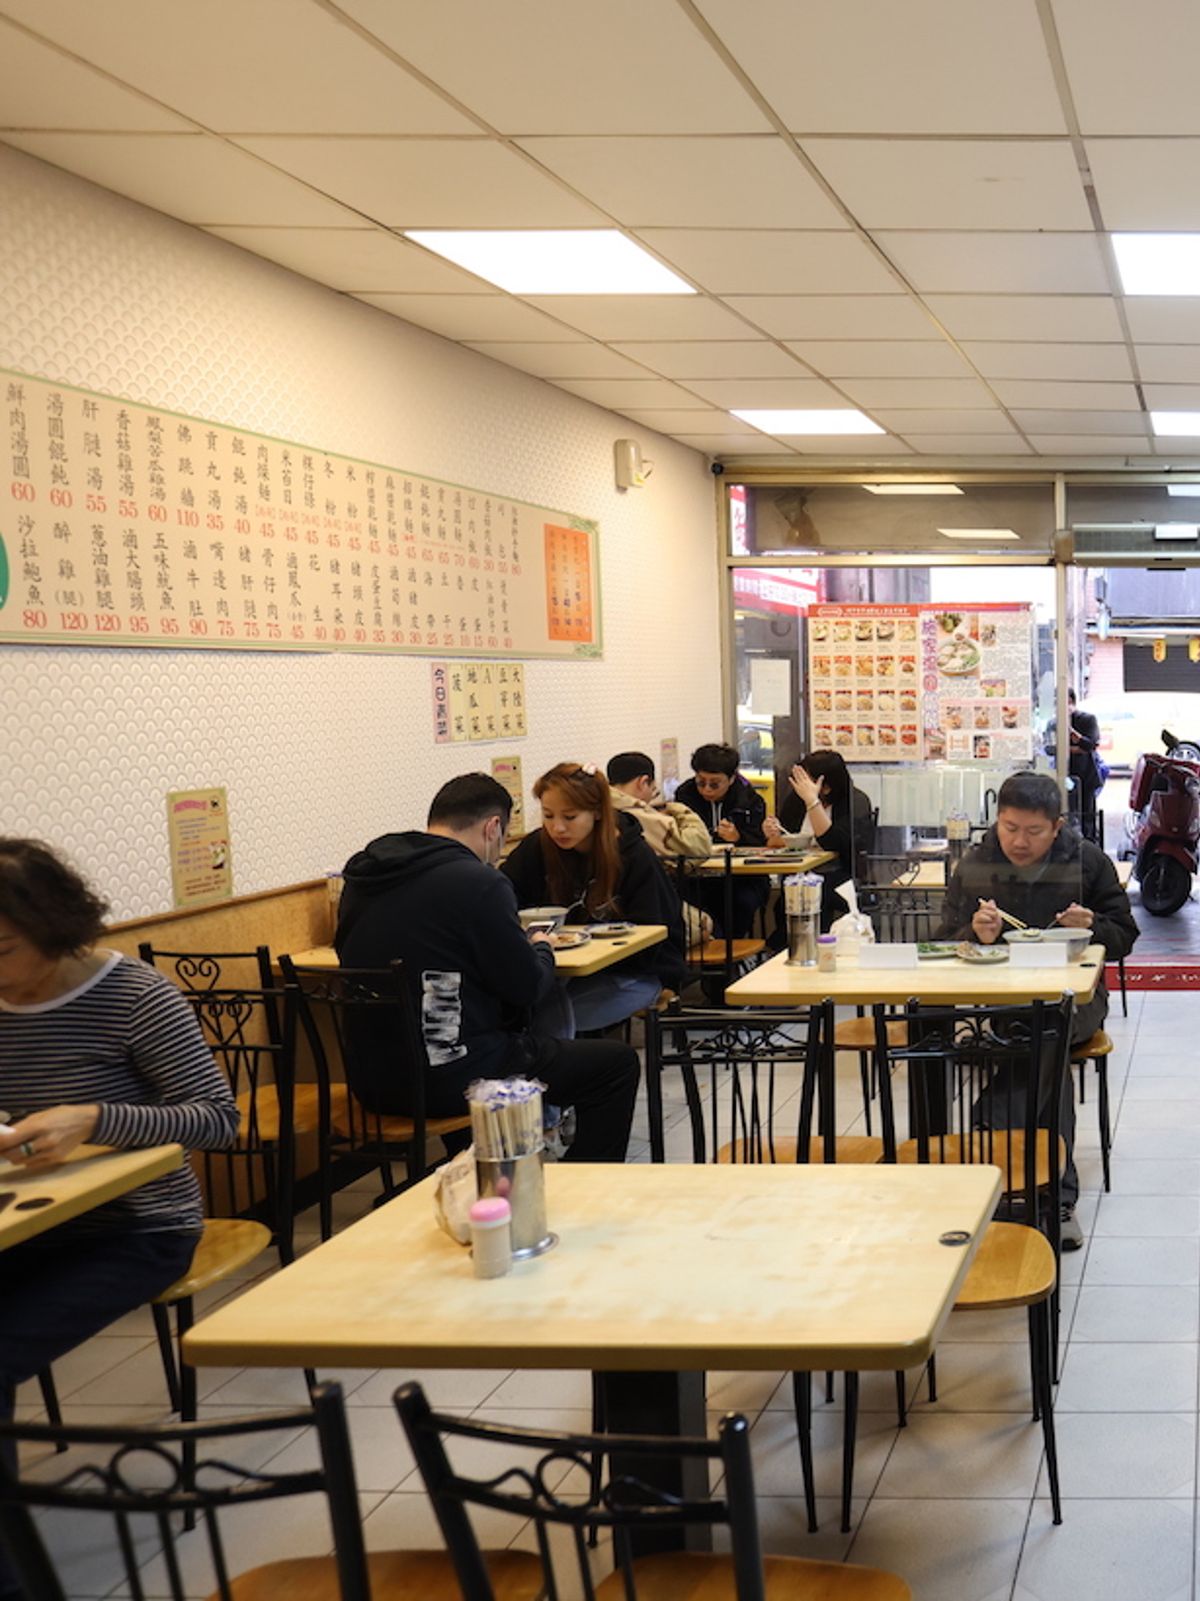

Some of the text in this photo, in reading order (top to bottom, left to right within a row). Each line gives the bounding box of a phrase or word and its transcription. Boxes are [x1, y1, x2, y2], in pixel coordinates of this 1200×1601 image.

[116, 409, 134, 497] 香菇雞湯
[205, 431, 221, 510] 貢丸湯
[11, 482, 35, 502] 60
[49, 488, 72, 508] 60
[85, 494, 107, 512] 55
[118, 500, 138, 518] 55
[148, 504, 167, 522] 60
[176, 509, 199, 527] 110
[206, 513, 224, 531] 35
[234, 518, 251, 535] 40
[260, 522, 275, 538] 45
[284, 527, 298, 541] 45
[305, 530, 319, 545] 45
[326, 534, 341, 548] 45
[348, 537, 362, 552] 45
[369, 540, 381, 554] 45
[19, 515, 44, 605] 沙拉鮑魚
[309, 553, 323, 622] 花生
[23, 609, 47, 629] 80
[60, 612, 88, 631] 120
[95, 614, 121, 632] 120
[129, 616, 149, 632] 95
[160, 618, 179, 634] 95
[189, 619, 208, 635] 90
[217, 620, 235, 637] 75
[243, 622, 260, 638] 75
[266, 622, 282, 639] 75
